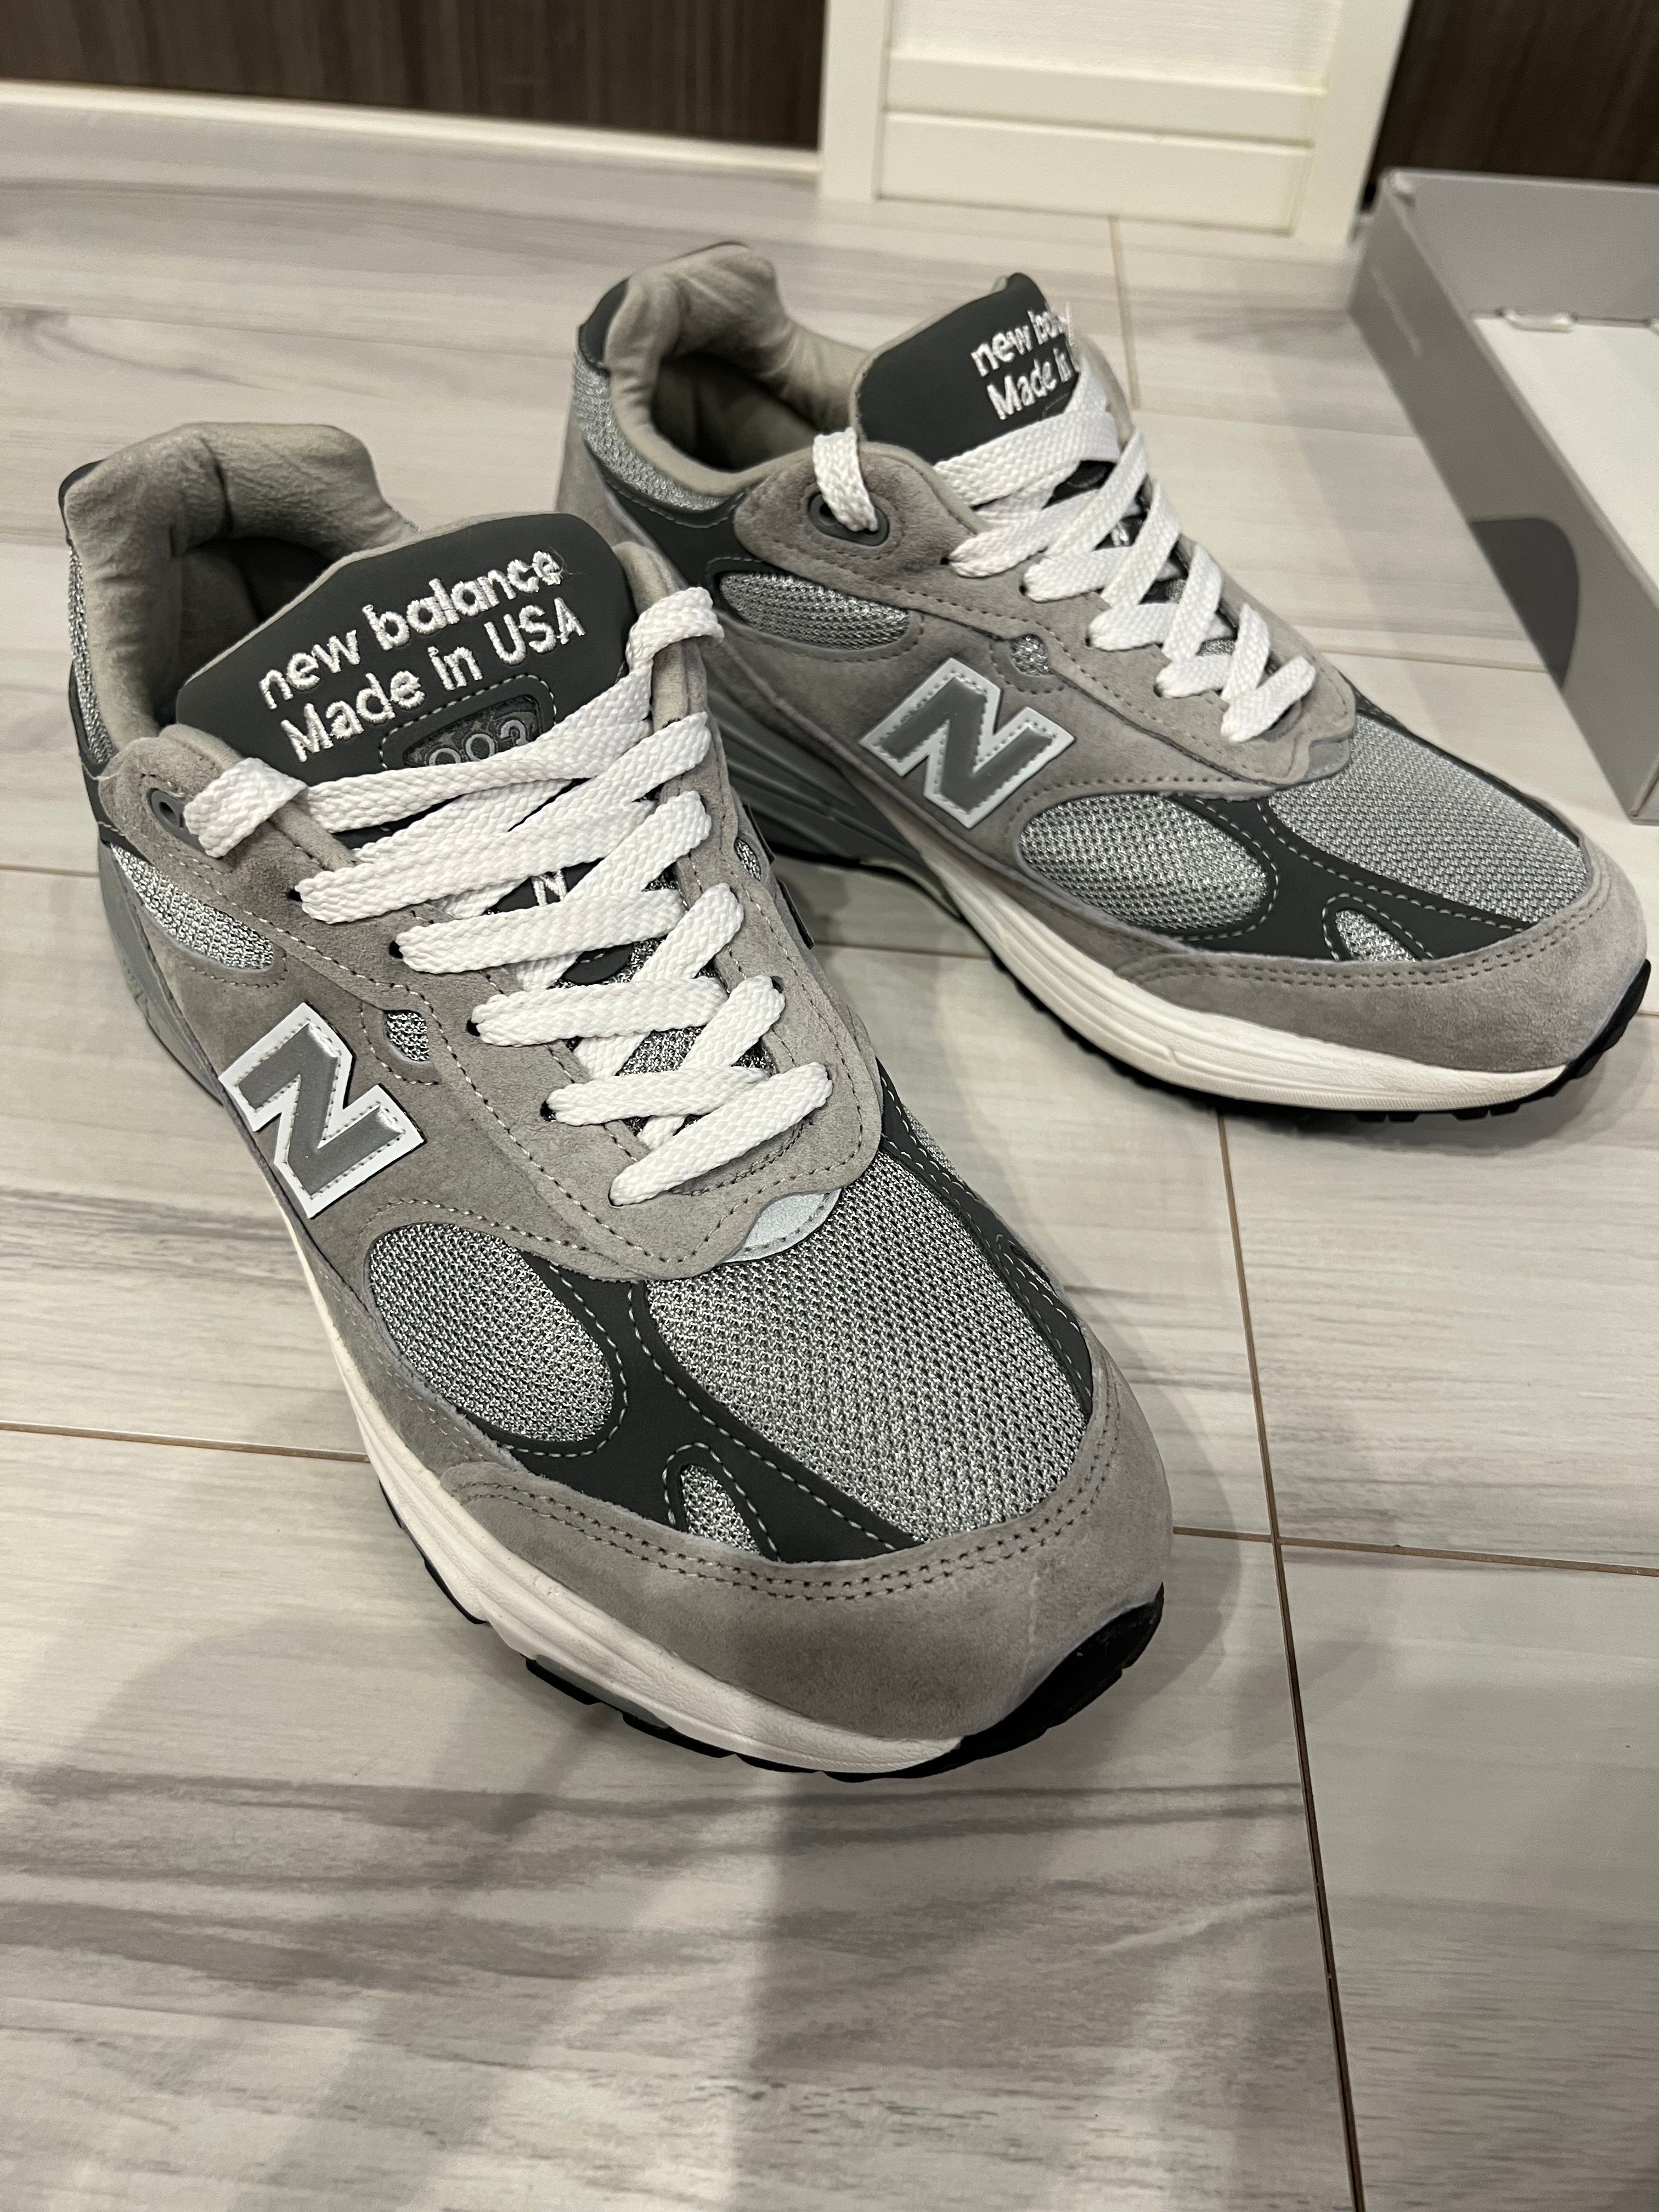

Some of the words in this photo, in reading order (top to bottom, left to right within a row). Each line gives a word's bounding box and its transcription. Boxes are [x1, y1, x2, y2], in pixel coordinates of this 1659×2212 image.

[970, 325, 1033, 377] new
[987, 358, 1057, 420] Made
[259, 630, 360, 710] new
[362, 550, 564, 651] balance
[280, 673, 426, 762] Made
[428, 646, 483, 691] in
[484, 597, 586, 665] USA
[859, 658, 1075, 829] N
[218, 1002, 425, 1219] N
